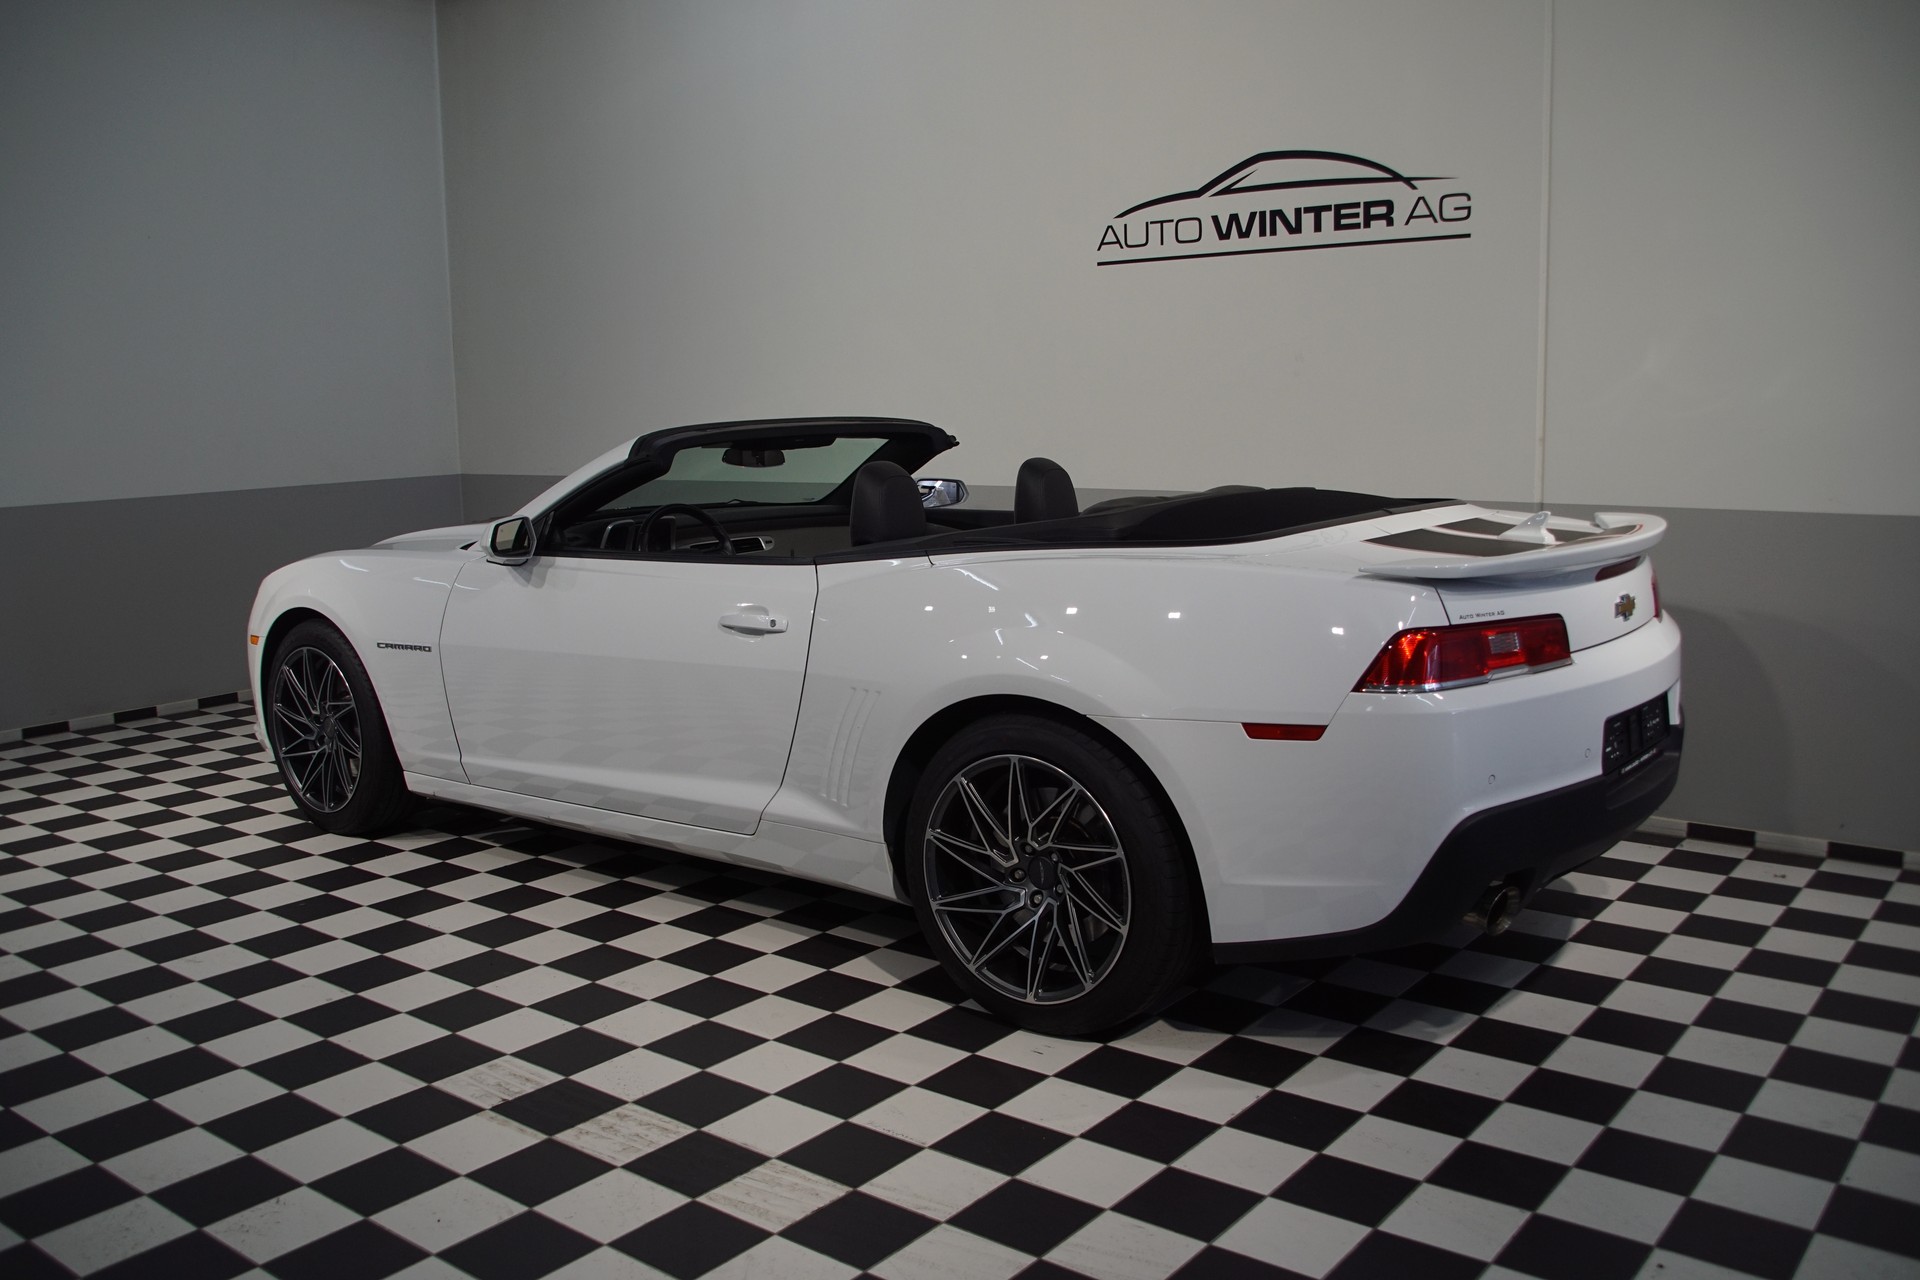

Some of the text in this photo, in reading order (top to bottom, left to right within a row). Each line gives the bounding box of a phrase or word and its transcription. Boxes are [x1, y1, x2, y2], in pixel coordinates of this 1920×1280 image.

[1097, 192, 1472, 251] AUTO WINTER AG
[376, 642, 432, 653] CAMARO
